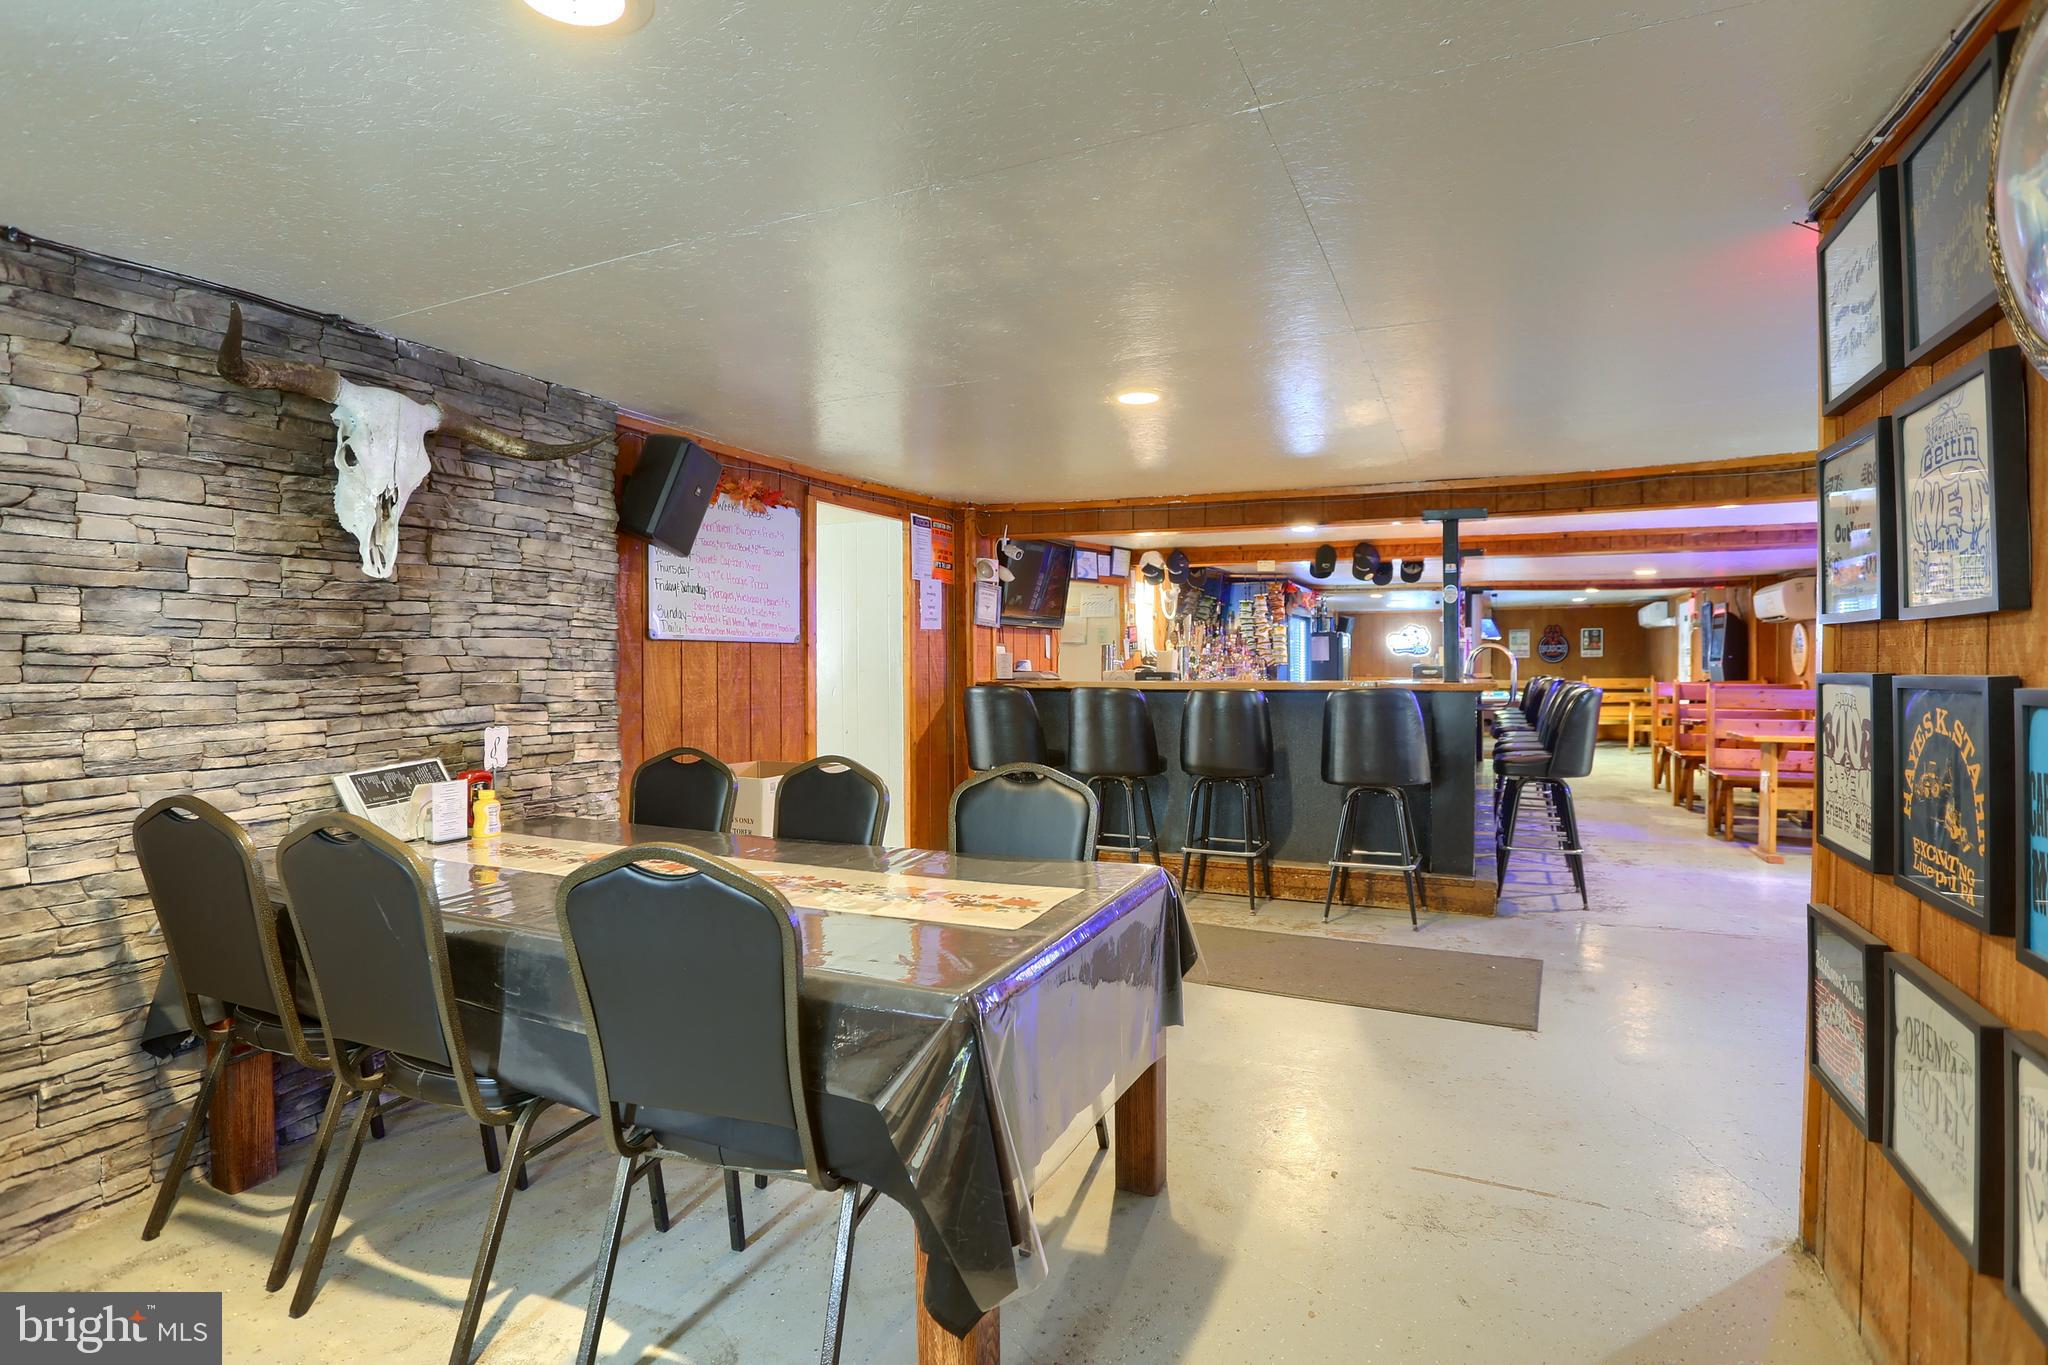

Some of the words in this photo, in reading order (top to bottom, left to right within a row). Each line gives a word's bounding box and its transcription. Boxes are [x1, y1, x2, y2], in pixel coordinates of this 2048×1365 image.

[1903, 711, 1935, 821] HAYES
[1903, 1060, 1965, 1151] HOTEL
[1904, 1016, 1972, 1126] ORIENTAL
